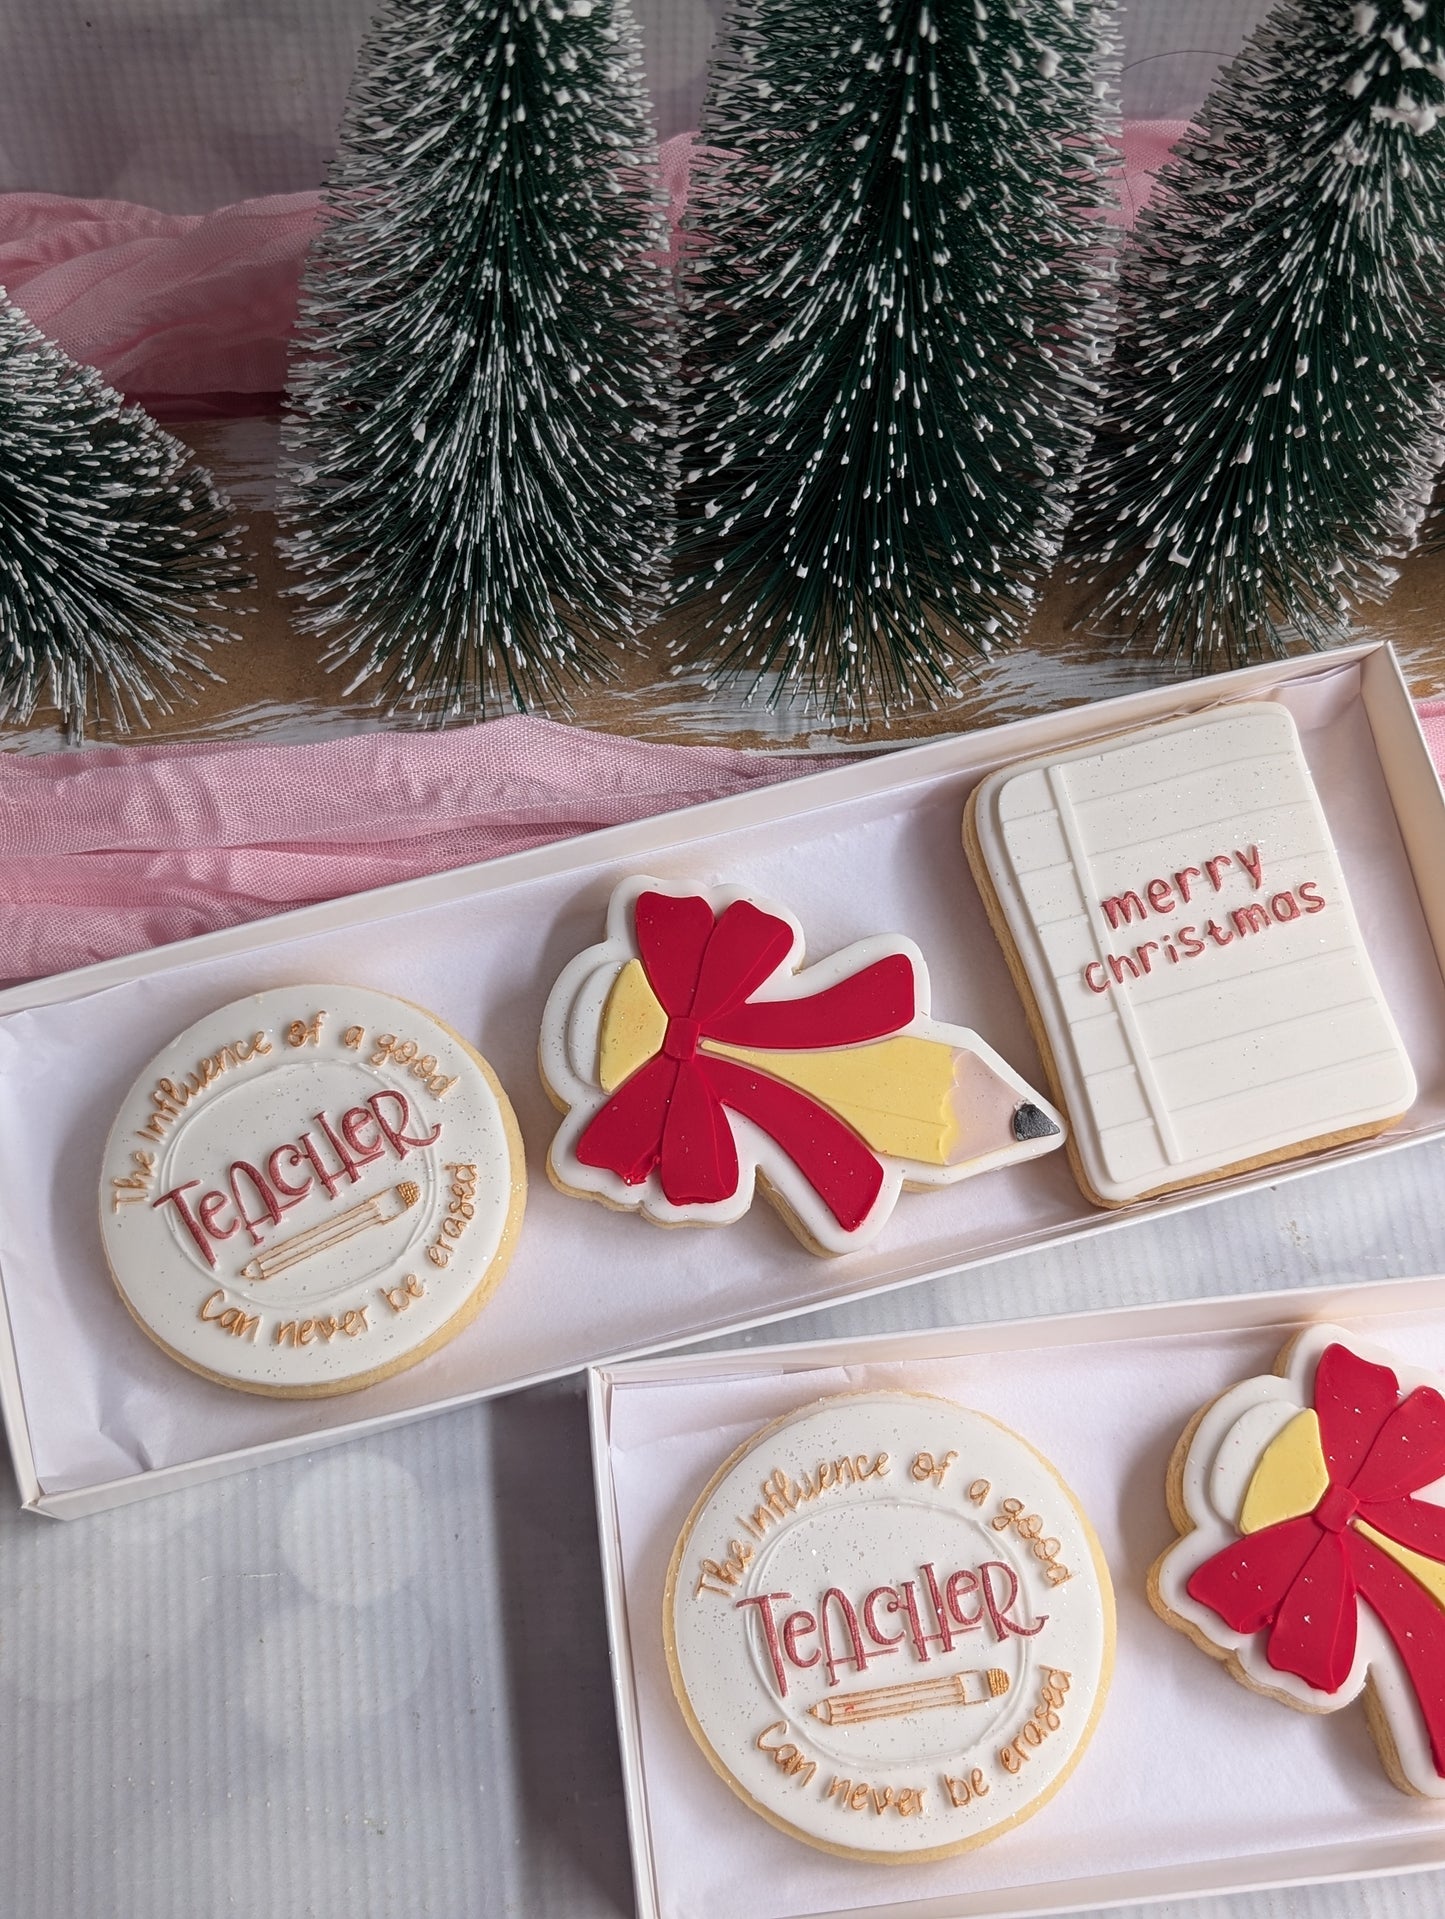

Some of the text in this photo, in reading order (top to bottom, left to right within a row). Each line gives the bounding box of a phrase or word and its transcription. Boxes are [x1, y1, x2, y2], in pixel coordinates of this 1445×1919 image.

[1085, 882, 1325, 993] christmas
[1101, 844, 1262, 929] merry
[112, 1148, 156, 1214] The
[287, 1010, 329, 1048] of
[344, 1025, 366, 1050] a
[370, 1033, 460, 1098] good
[199, 1162, 479, 1347] Can never be erased
[697, 1539, 755, 1597] The
[911, 1450, 959, 1487] of
[968, 1479, 992, 1506] a
[993, 1498, 1076, 1588] good
[756, 1665, 1072, 1817] Can never be erased
